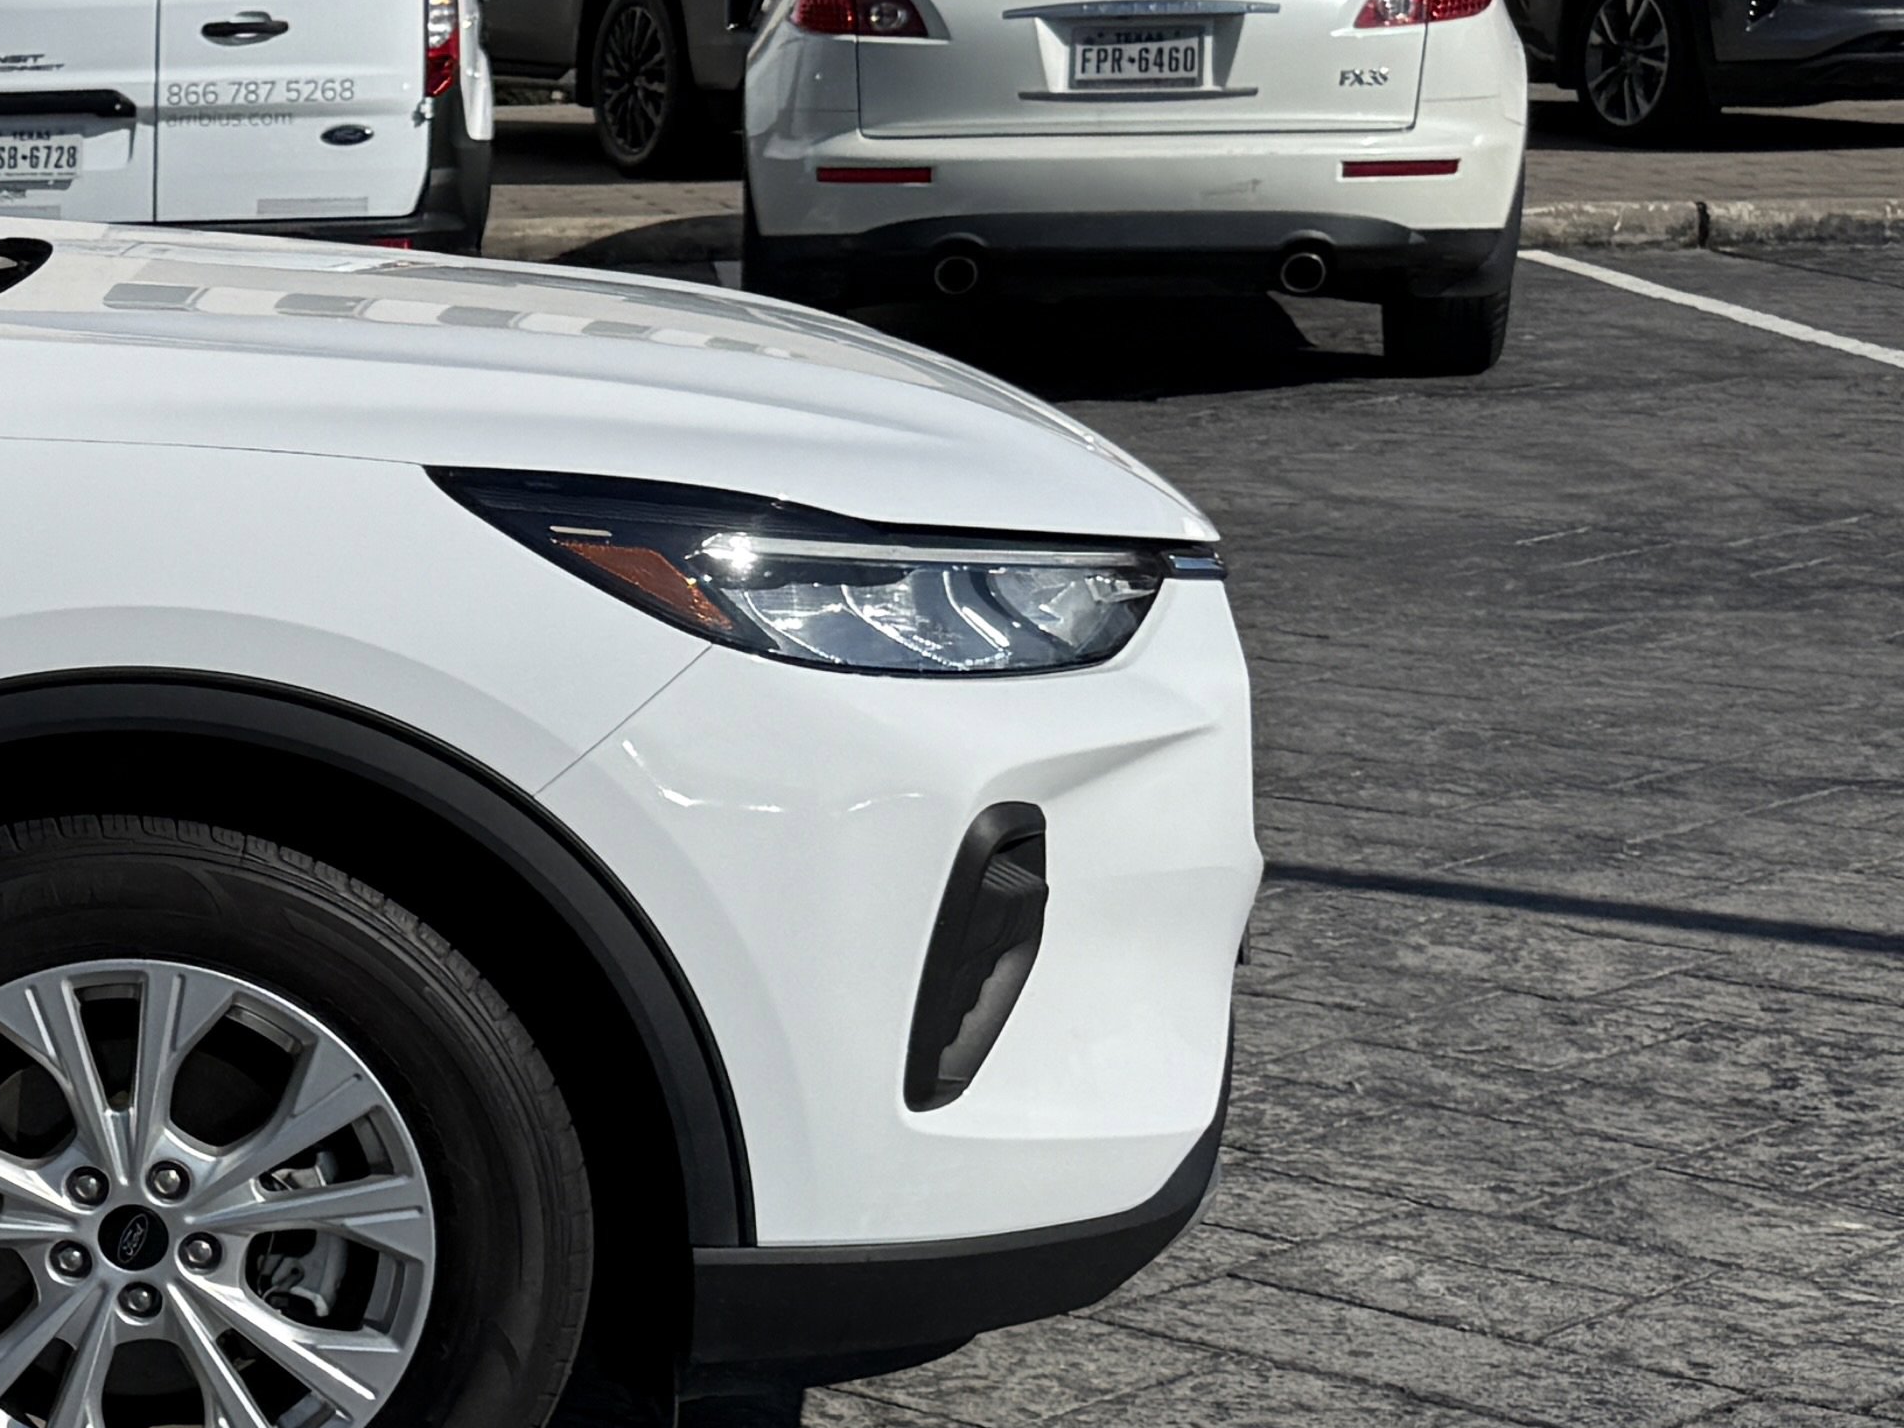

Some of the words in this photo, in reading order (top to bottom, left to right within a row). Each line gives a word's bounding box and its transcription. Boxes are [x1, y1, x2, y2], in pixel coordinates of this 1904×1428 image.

[167, 82, 218, 106] 866
[227, 80, 276, 104] 787
[285, 78, 355, 103] 5268
[166, 110, 294, 128] ambius.com
